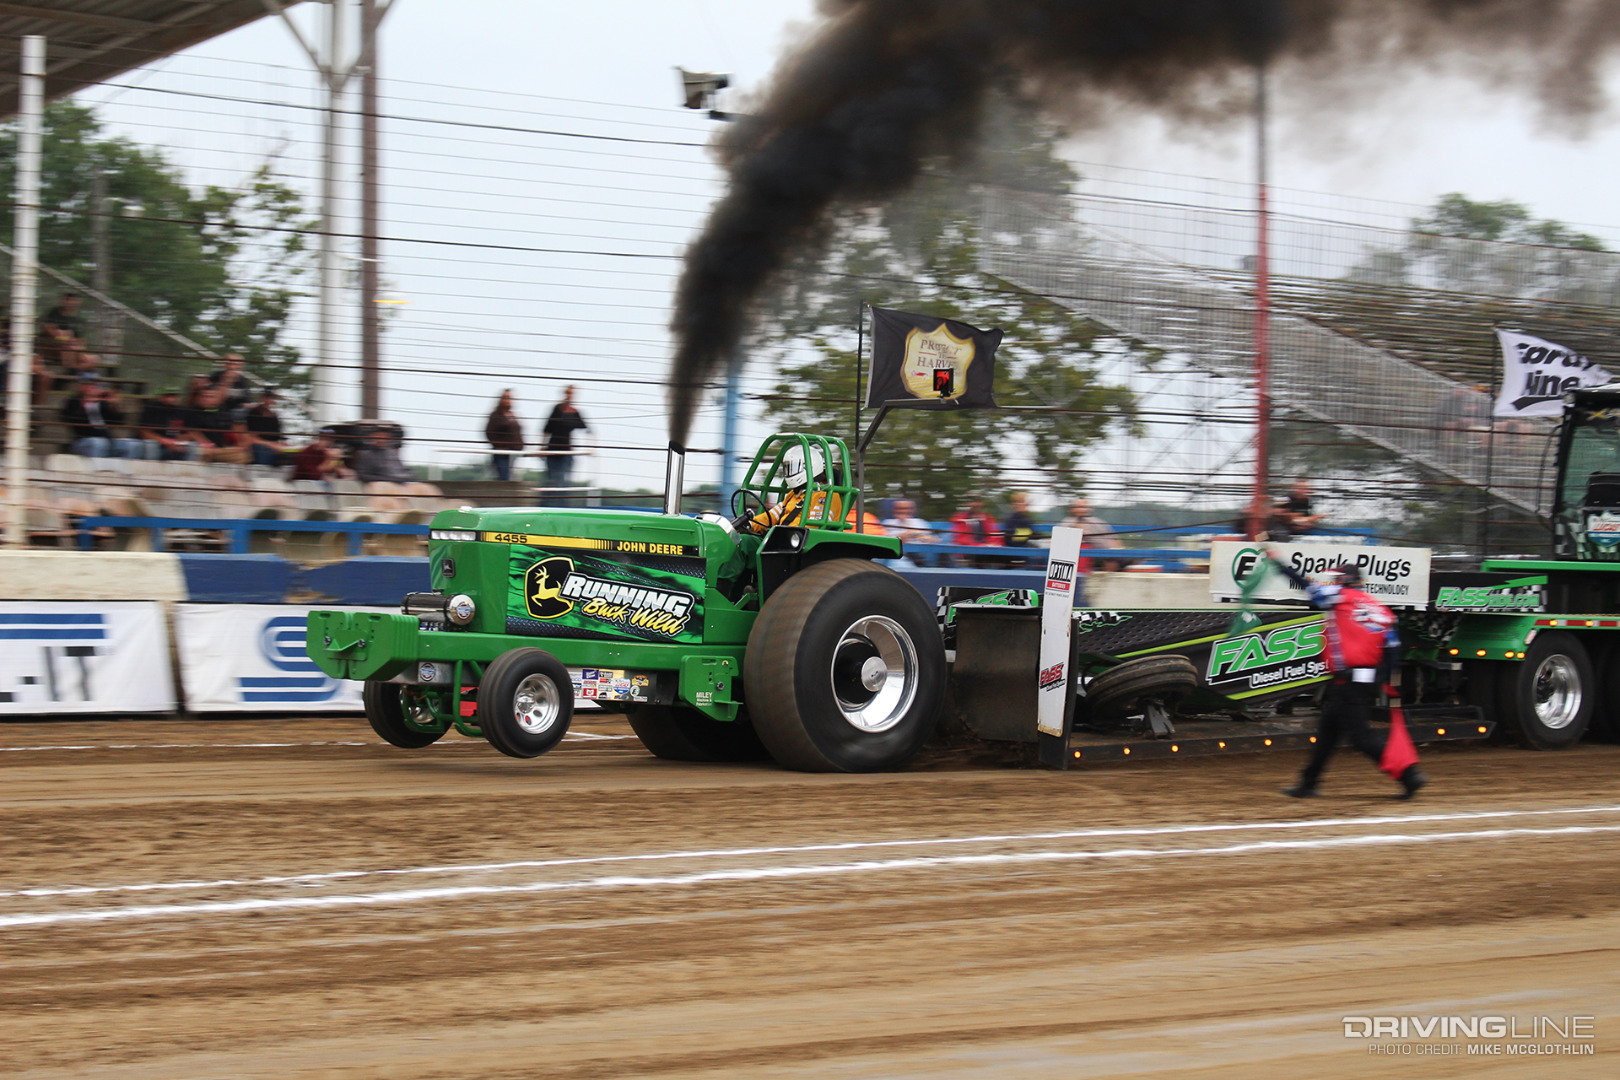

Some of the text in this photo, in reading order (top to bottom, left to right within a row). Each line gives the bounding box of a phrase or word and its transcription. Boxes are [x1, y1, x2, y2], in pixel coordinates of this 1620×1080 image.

[494, 533, 528, 544] 4455
[617, 541, 683, 555] JOHN DEERE
[1049, 562, 1074, 581] OPTIMA
[1288, 551, 1348, 577] Spark
[1356, 554, 1412, 582] Plugs
[561, 574, 691, 618] RUNNING
[1365, 583, 1410, 595] TECHNOLOGY
[583, 597, 688, 635] Buck Wild
[1208, 623, 1328, 678] FASS
[1039, 663, 1064, 686] FASS
[1252, 668, 1283, 685] Diesel
[1284, 662, 1307, 678] Fuel
